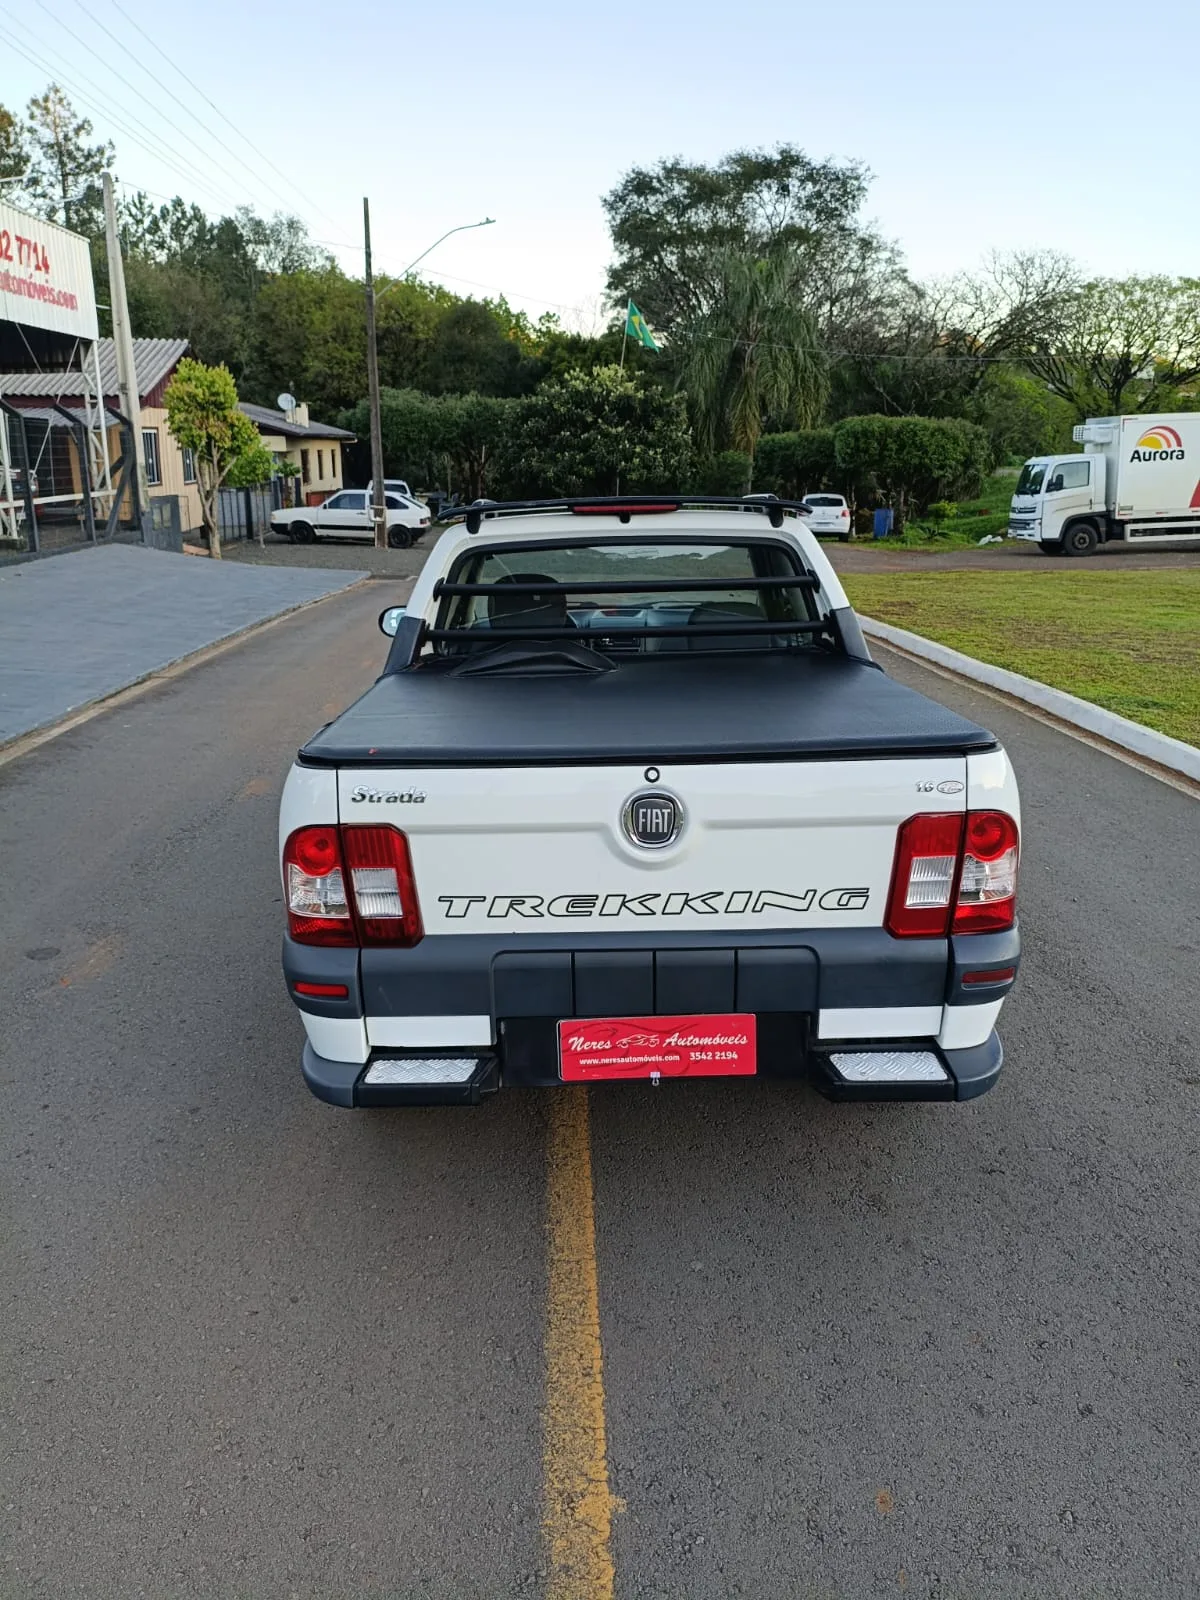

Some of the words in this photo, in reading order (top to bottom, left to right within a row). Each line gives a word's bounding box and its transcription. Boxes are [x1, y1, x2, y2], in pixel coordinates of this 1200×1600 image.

[15, 234, 50, 274] 7714
[1130, 449, 1185, 463] Aurora
[351, 784, 427, 804] Strada
[638, 808, 671, 833] FIAT
[437, 887, 870, 918] TREKKING
[568, 1036, 612, 1051] Neres
[662, 1032, 748, 1048] Automóveis
[579, 1054, 680, 1065] www.neresautomóveis.com
[690, 1051, 713, 1061] 3542
[715, 1051, 738, 1060] 2194
